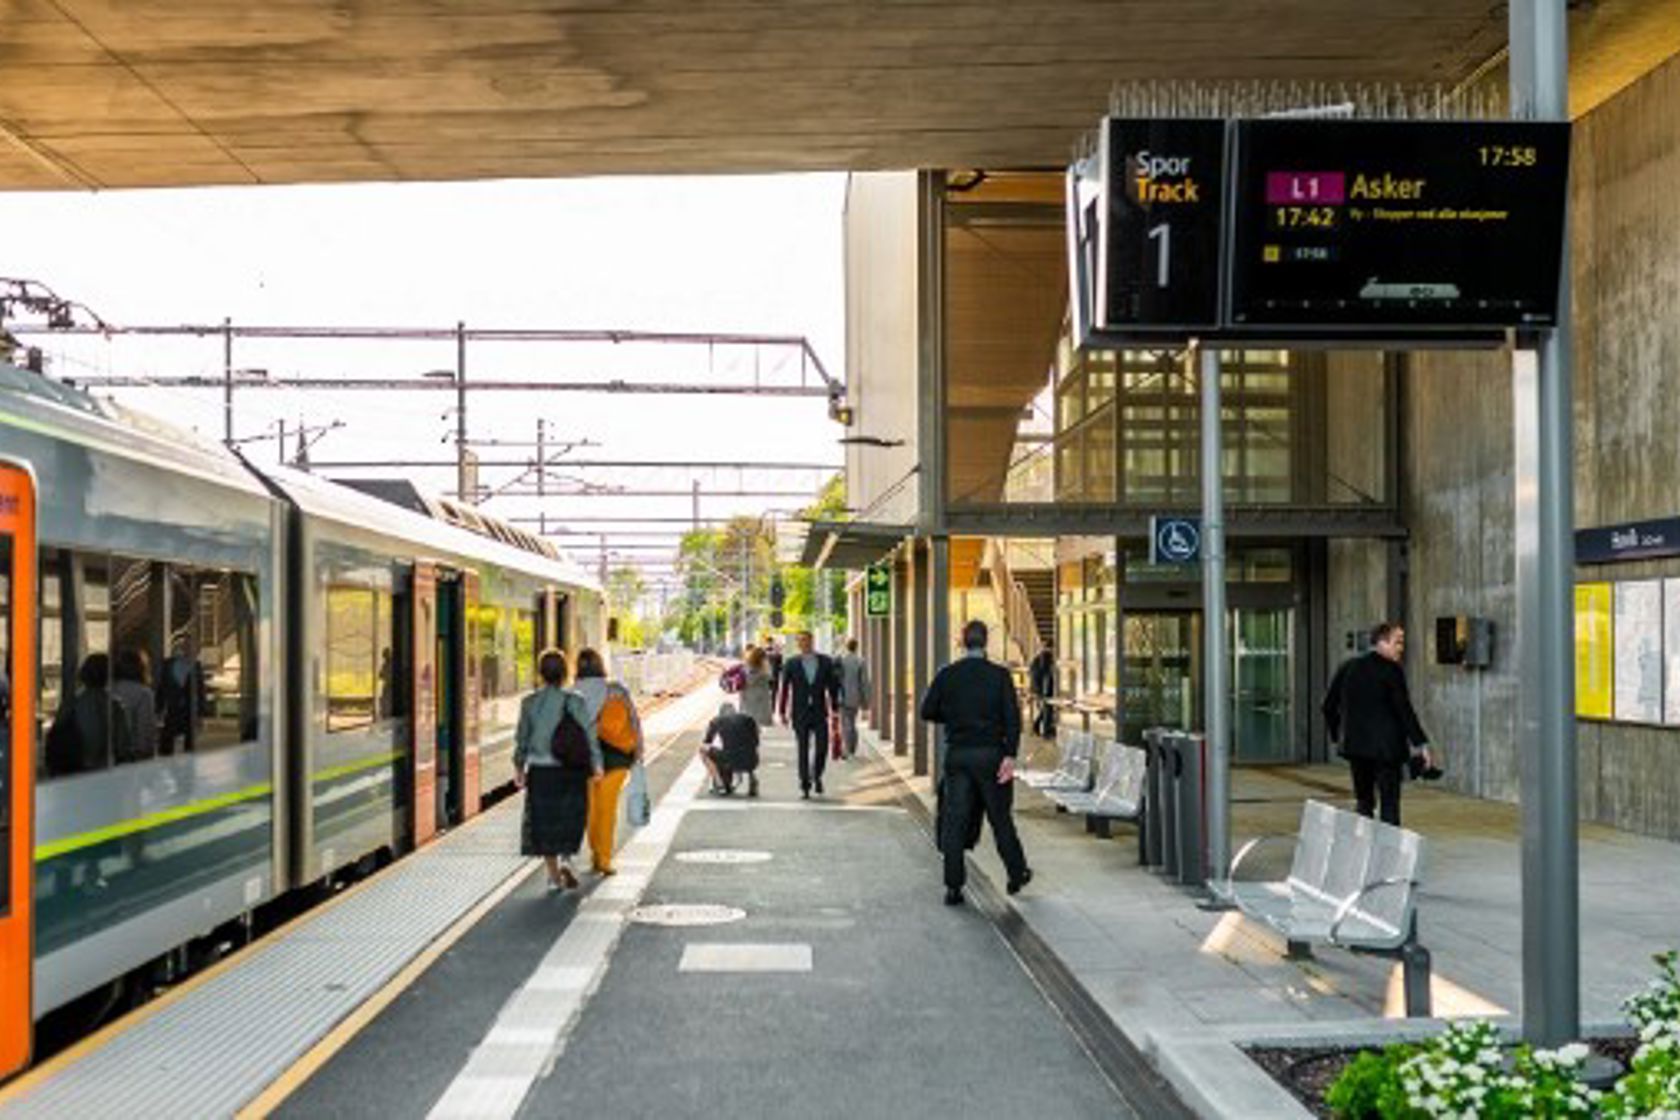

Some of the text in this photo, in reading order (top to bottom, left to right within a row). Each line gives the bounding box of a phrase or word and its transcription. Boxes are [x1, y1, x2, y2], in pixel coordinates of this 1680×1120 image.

[1135, 149, 1190, 179] Spor
[1478, 146, 1537, 167] 17:58
[1134, 177, 1199, 203] Track
[1349, 172, 1427, 200] Asker
[1276, 206, 1335, 227] 17:42
[1148, 223, 1171, 288] 1
